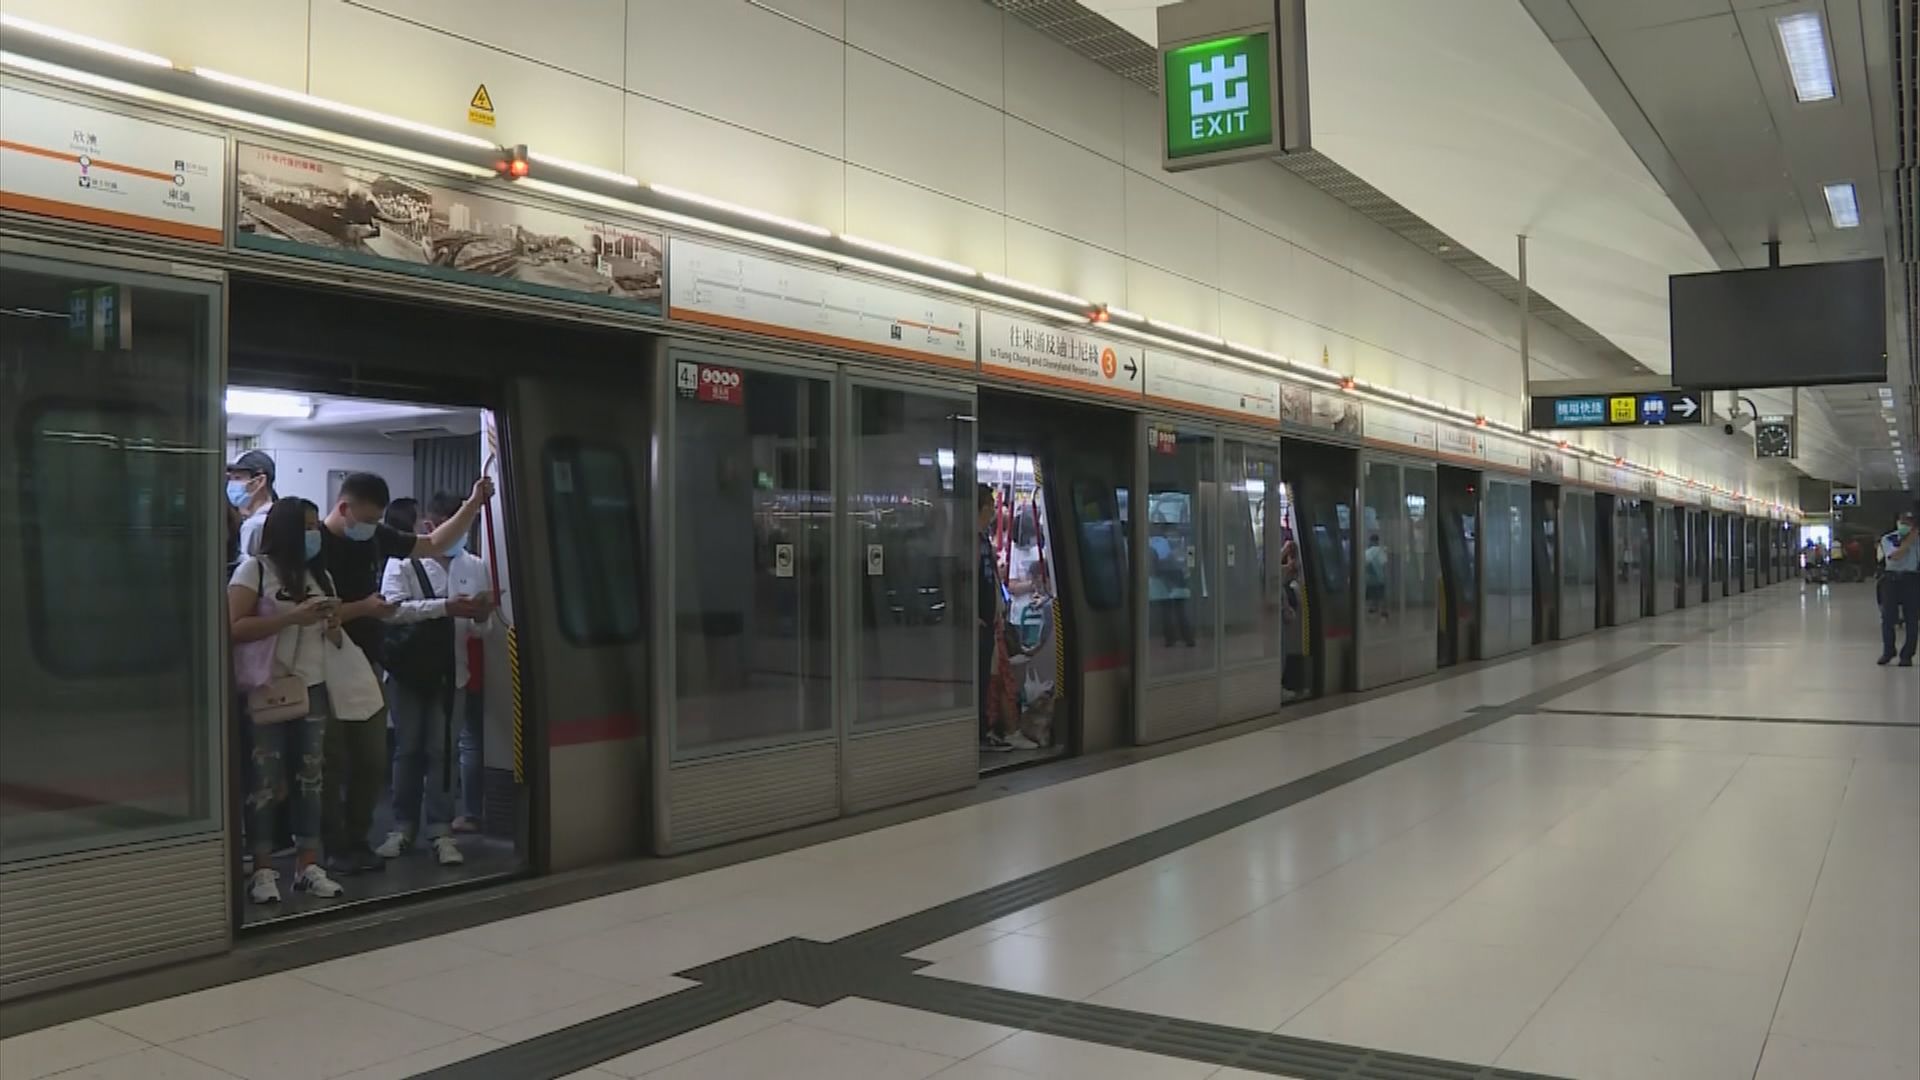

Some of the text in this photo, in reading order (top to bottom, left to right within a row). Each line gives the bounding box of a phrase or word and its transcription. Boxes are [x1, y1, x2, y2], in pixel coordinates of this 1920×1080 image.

[1189, 54, 1248, 116] 出
[1191, 110, 1249, 140] EXIT
[990, 348, 997, 358] to
[998, 348, 1012, 363] Tung
[1013, 351, 1031, 367] Chung
[1032, 357, 1042, 367] and
[1043, 359, 1072, 371] Disneyland
[1073, 364, 1088, 375] Resort
[1106, 352, 1113, 373] 3
